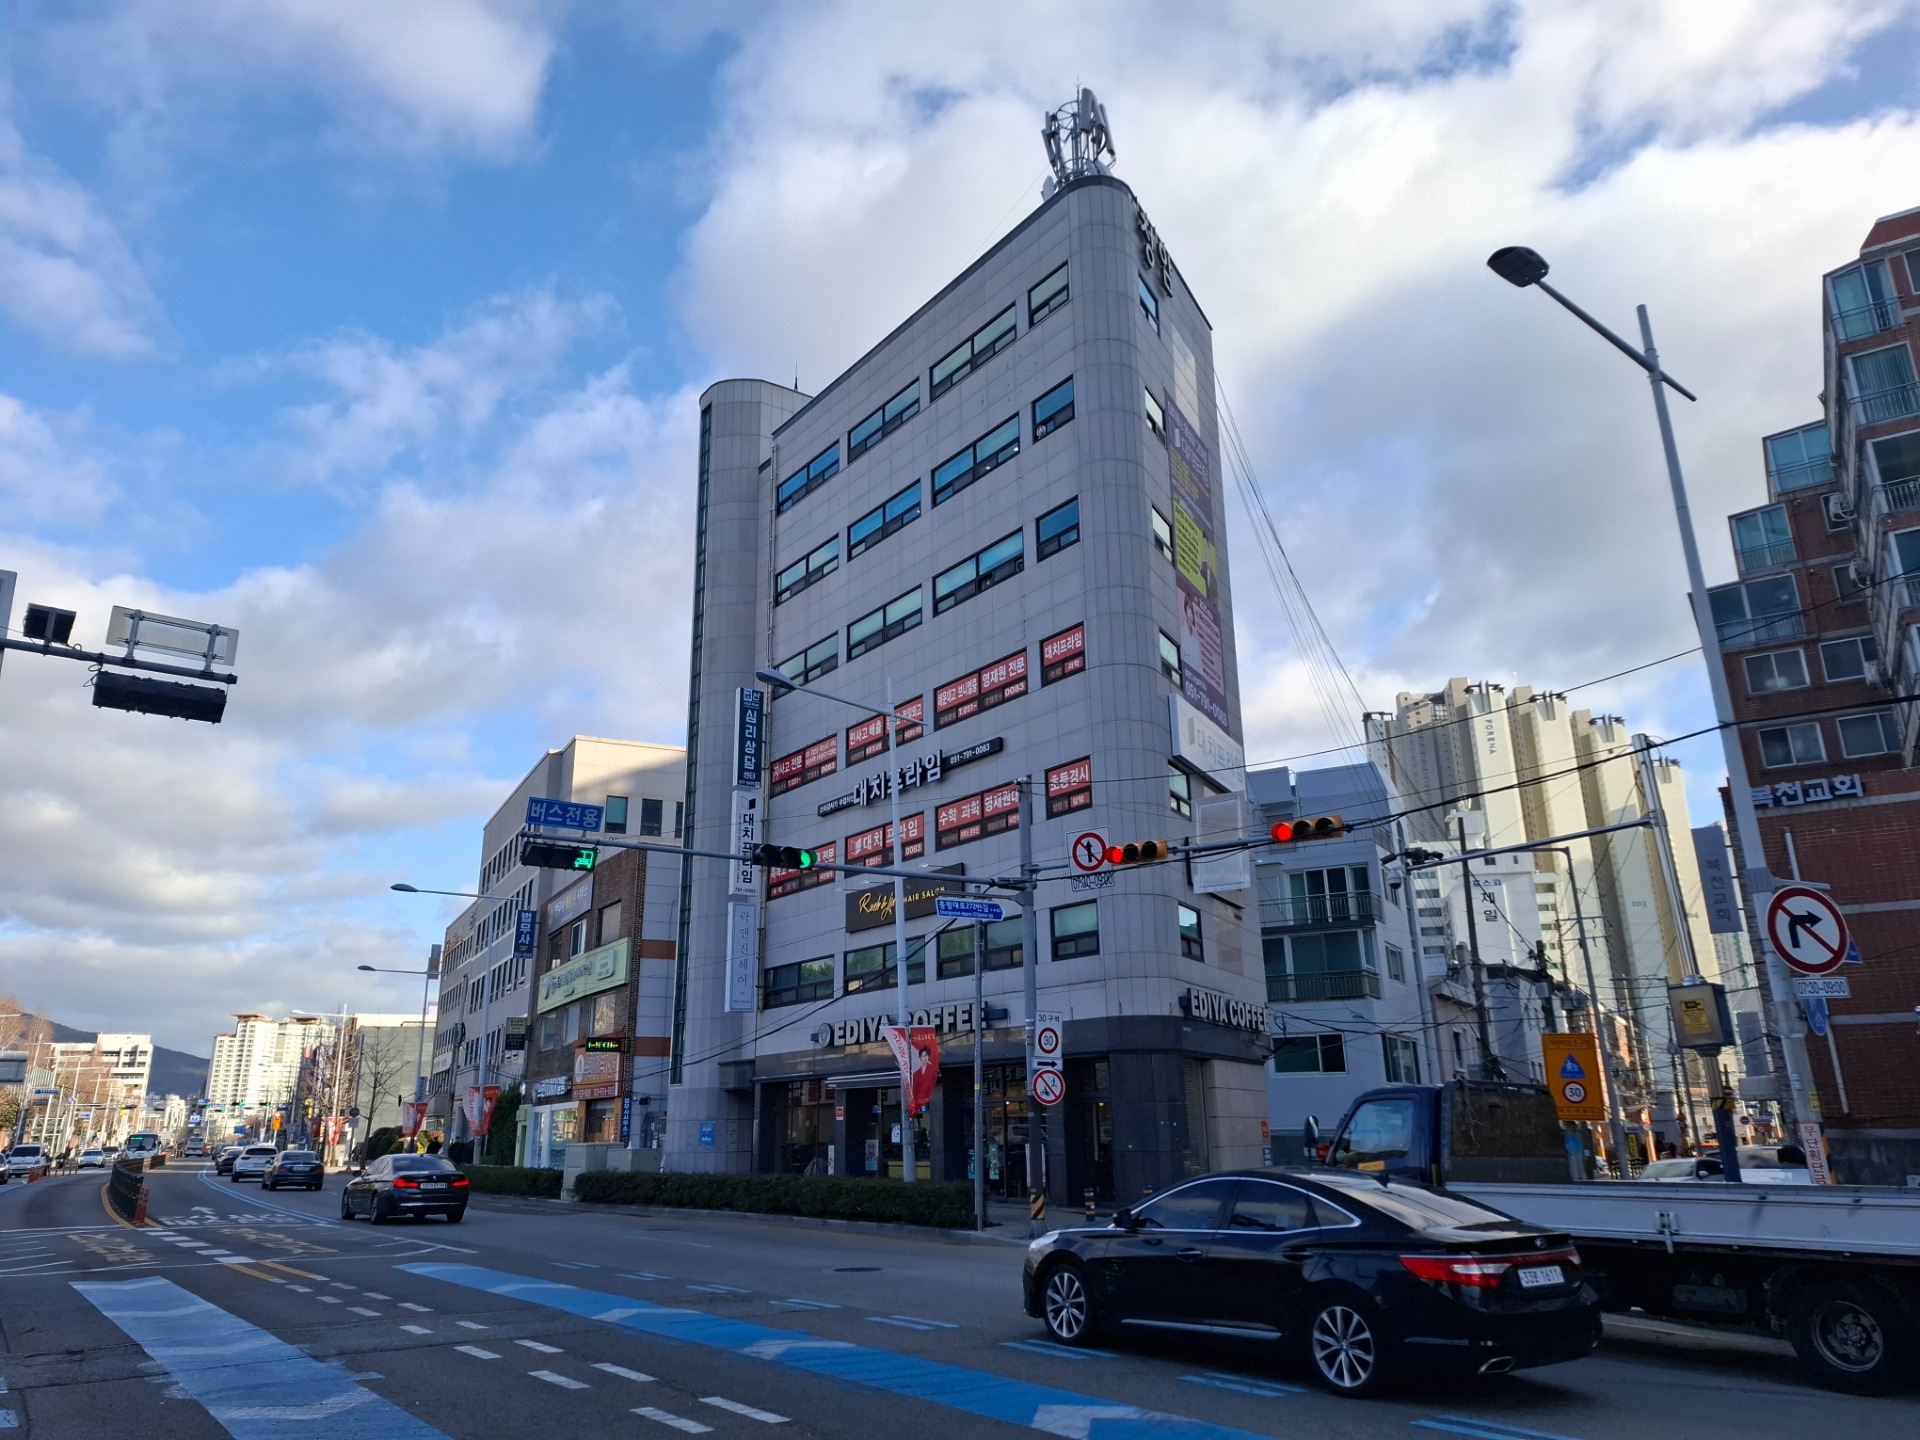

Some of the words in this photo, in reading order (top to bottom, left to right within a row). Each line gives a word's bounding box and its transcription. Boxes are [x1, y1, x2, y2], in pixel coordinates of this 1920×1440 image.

[1044, 631, 1082, 659] 대치프라임
[982, 664, 1006, 688] 영재원
[1008, 656, 1025, 677] 전문
[1004, 682, 1024, 697] 0083
[744, 709, 757, 770] 심리상담
[849, 727, 868, 745] 민사고
[1484, 718, 1497, 755] FORENA
[949, 742, 991, 765] 051-791-0083
[1050, 764, 1089, 791] 초등경시
[530, 801, 599, 829] 버스전용
[939, 807, 957, 826] 수학
[961, 799, 980, 819] 과학
[905, 844, 921, 855] 0083
[1631, 900, 1647, 909] 103
[518, 911, 533, 945] 법무사
[1037, 1013, 1047, 1022] 30
[1048, 1014, 1060, 1024] 구역
[1190, 987, 1228, 1024] EDIYA
[1229, 1000, 1270, 1032] COFFEE
[833, 1014, 891, 1046] EDIYA
[1043, 1034, 1054, 1047] 30
[1568, 1087, 1582, 1098] 30
